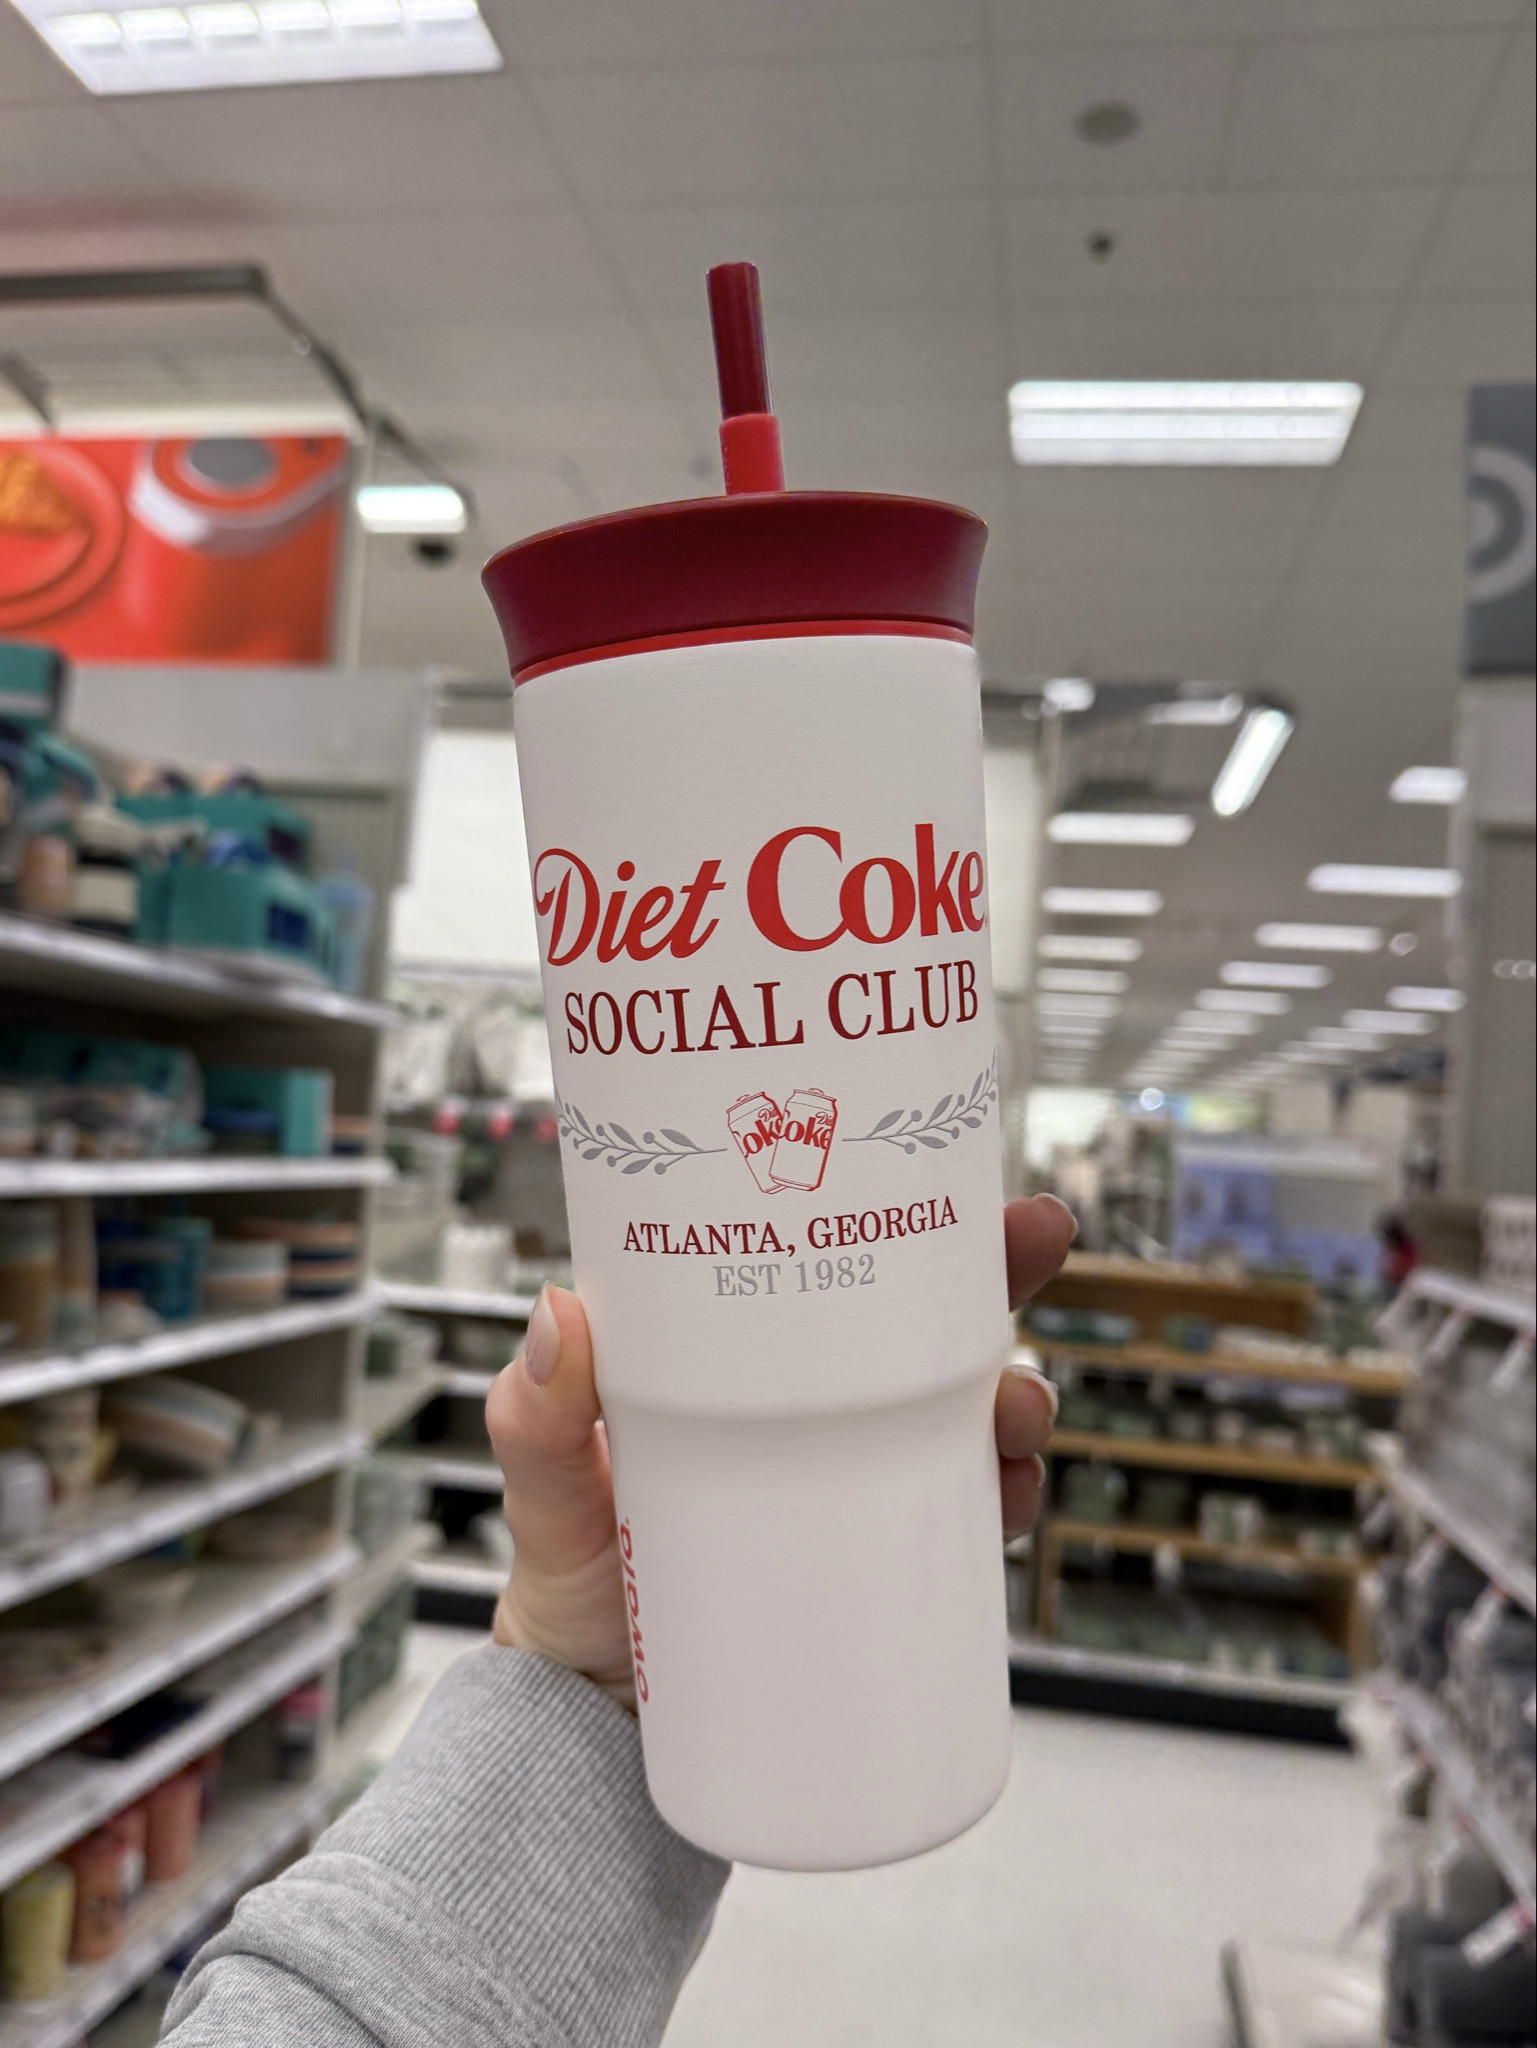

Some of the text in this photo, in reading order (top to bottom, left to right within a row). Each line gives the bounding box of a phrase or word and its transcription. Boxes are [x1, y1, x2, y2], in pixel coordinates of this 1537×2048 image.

[534, 823, 987, 966] Diet Coke
[565, 959, 978, 1055] SOCIAL CLUB
[623, 1195, 958, 1257] ATLANTA, GEORGIA
[713, 1253, 876, 1297] EST 1982
